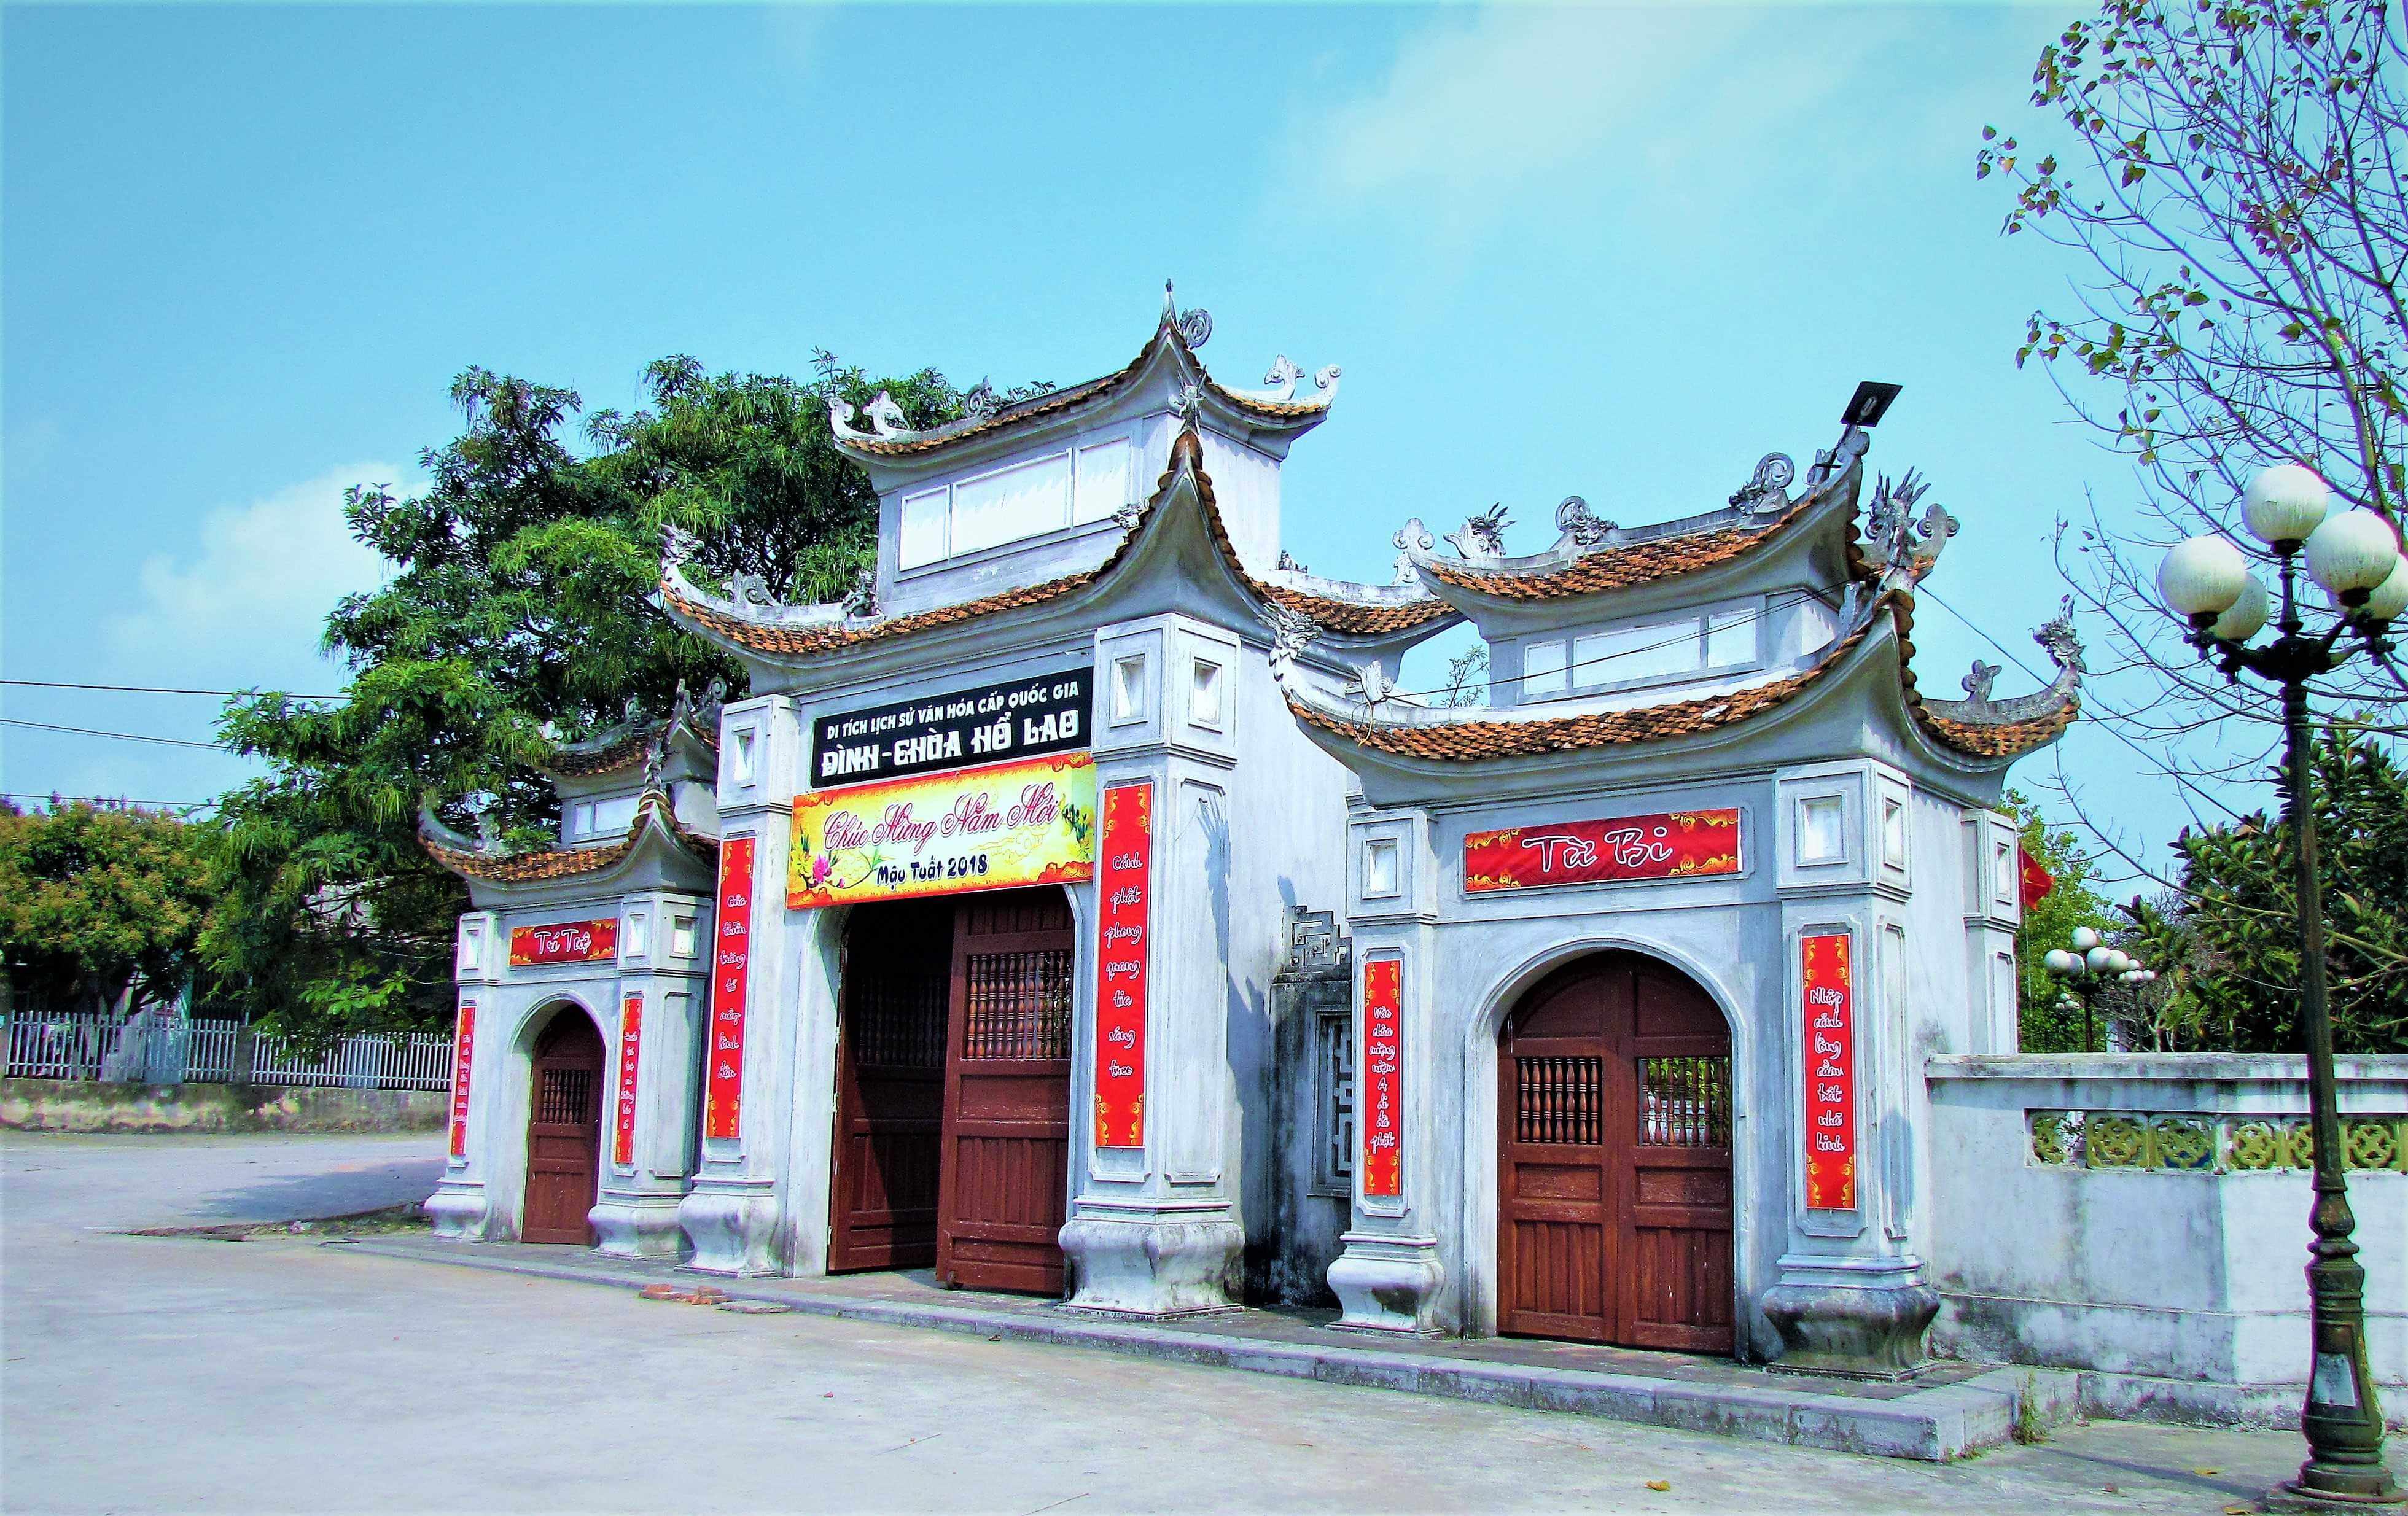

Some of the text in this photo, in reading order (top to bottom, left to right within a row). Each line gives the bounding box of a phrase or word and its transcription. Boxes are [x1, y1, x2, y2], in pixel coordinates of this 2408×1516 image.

[827, 681, 1079, 741] DI TÍCH LỊCH SỬ VĂN HÓA CẤP QUỐC GIA
[970, 712, 1012, 754] HỔ
[1023, 709, 1080, 746] LAO
[824, 781, 1060, 855] Chúc Mừng Năm Mới
[1112, 852, 1143, 871] Cảnh
[1604, 826, 1674, 868] Bi
[876, 853, 989, 891] Mậu Tuất 2018
[1110, 885, 1142, 914] phật
[1104, 922, 1142, 949] phong
[1105, 960, 1140, 982] quang
[1108, 1026, 1136, 1049] sáng
[1377, 1076, 1388, 1092] A
